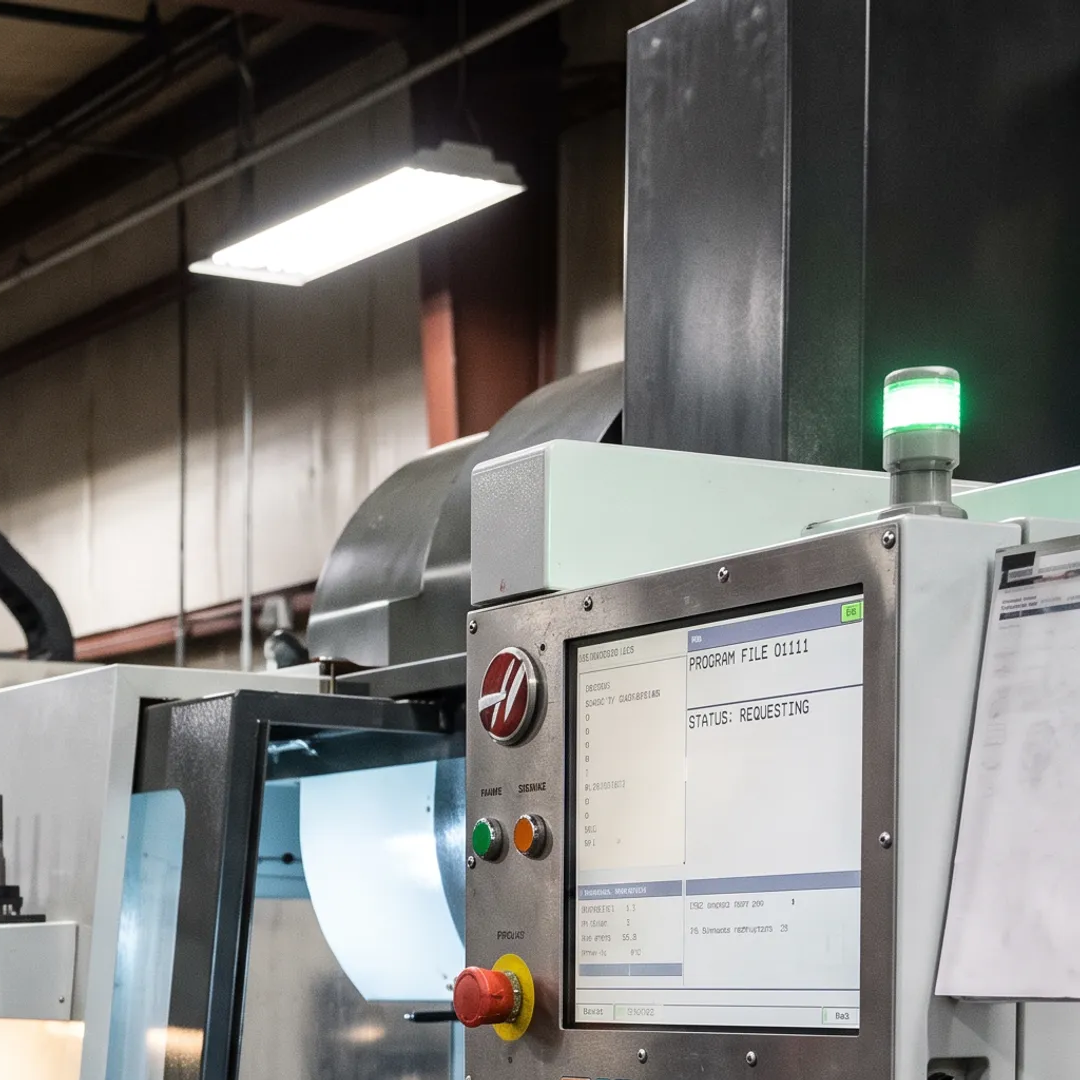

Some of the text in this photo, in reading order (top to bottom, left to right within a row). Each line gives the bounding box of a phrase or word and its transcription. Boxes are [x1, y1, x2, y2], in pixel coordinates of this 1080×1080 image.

[689, 650, 736, 671] PROGRAM
[741, 645, 768, 663] FILE
[689, 699, 810, 729] STATUS: REQUESTING
